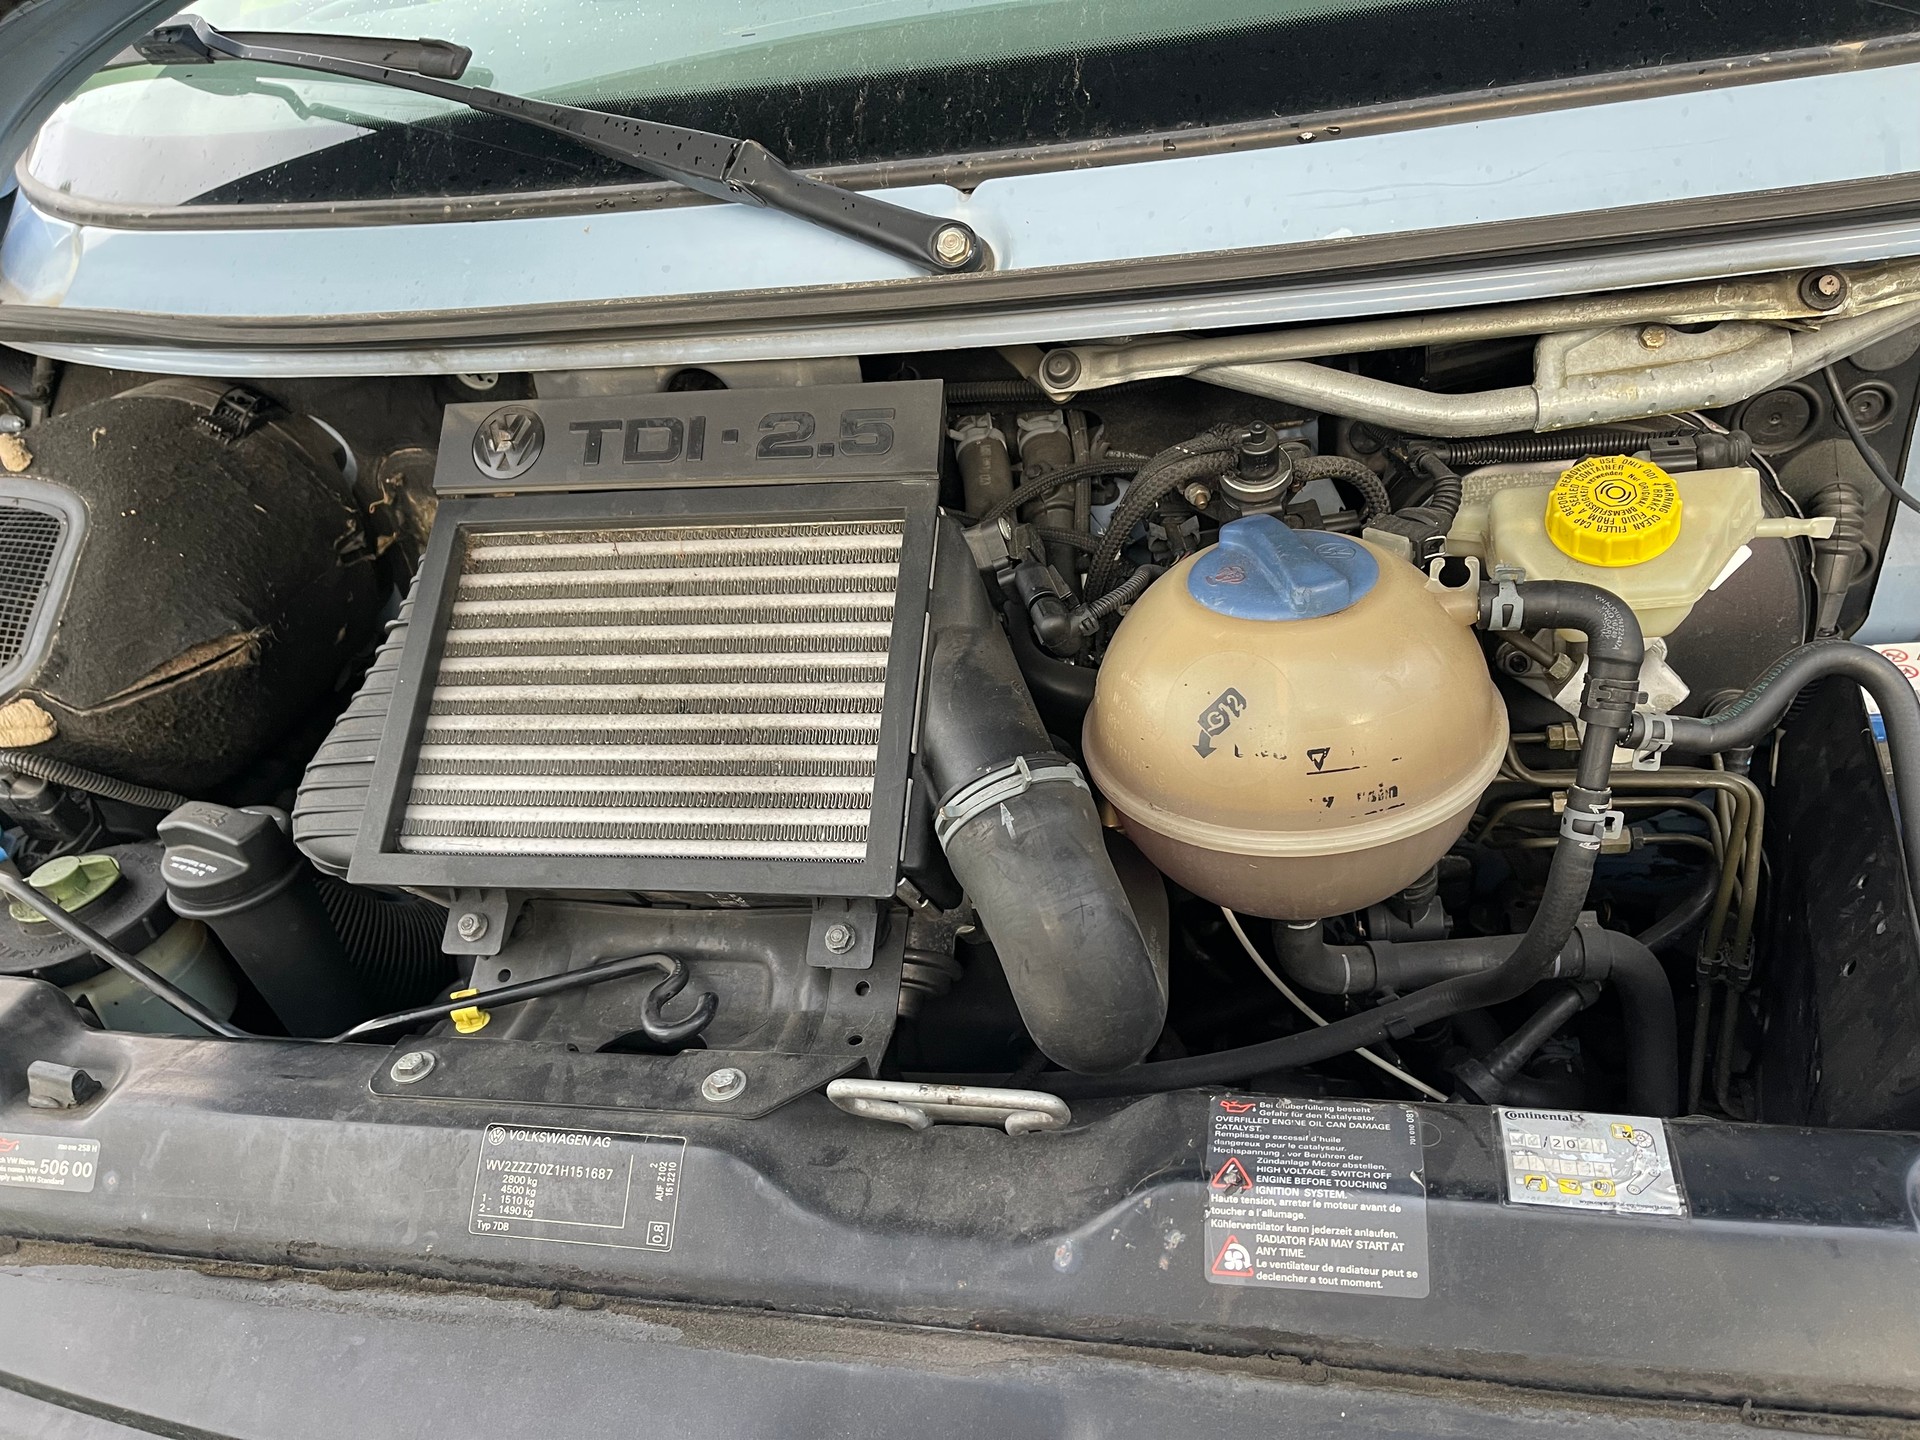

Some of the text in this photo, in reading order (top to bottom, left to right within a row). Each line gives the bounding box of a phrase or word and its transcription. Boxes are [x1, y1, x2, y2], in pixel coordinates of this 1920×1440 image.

[569, 415, 706, 466] TDI
[756, 408, 896, 461] 2.5
[1622, 458, 1645, 469] ONLY
[1560, 460, 1595, 488] REMOVING
[1575, 464, 1625, 482] CONTAINER
[1586, 471, 1624, 485] verwenden
[1643, 469, 1659, 480] DOT
[1568, 483, 1581, 507] SEALED
[1646, 488, 1663, 512] BRAKE
[1659, 482, 1674, 513] WARNING
[1557, 492, 1575, 517] BEFORE
[1574, 518, 1592, 529] CAP
[1588, 512, 1615, 525] FROM
[1621, 511, 1647, 525] FLUID
[1633, 514, 1661, 531] CLEAN
[1596, 524, 1627, 533] FILLER
[1207, 694, 1244, 733] G12
[1259, 1109, 1289, 1117] Gefahr
[1291, 1110, 1303, 1118] für
[1325, 1113, 1377, 1122] Katalysator.
[1405, 1110, 1414, 1123] 081
[1504, 1110, 1573, 1122] Continental
[1215, 1116, 1391, 1131] OVERFILLED ENGINE OIL CAN DAMAGE
[1215, 1123, 1263, 1132] CATALYST.
[509, 1129, 612, 1148] VOLKSWAGEN AG
[1214, 1131, 1342, 1143] Remplissage excessif d'huile
[1213, 1139, 1261, 1148] dangereux
[1298, 1143, 1347, 1152] catalyseur.
[1213, 1147, 1280, 1157] Hochspannung
[6, 1156, 18, 1165] VW
[1256, 1157, 1387, 1170] Zündanlage Motor abstellen.
[27, 1167, 39, 1175] VW
[40, 1159, 93, 1178] 506 00
[486, 1159, 614, 1181] WV2ZZZ70Z1H151687
[1331, 1169, 1371, 1178] SWITCH
[1373, 1171, 1392, 1179] OFF
[25, 1175, 37, 1183] VW
[502, 1174, 538, 1188] 2800 kg
[655, 1161, 668, 1202] AUF Z102
[665, 1161, 677, 1196] 1512210
[1256, 1175, 1388, 1190] ENGINE BEFORE TOUCHING
[500, 1184, 537, 1198] 4500 kg
[1255, 1186, 1348, 1199] IGNITION SYSTEM.
[500, 1194, 523, 1205] 1510
[524, 1197, 535, 1208] kg
[1210, 1194, 1239, 1204] Haute
[1240, 1196, 1277, 1206] tension,
[1313, 1199, 1322, 1208] le
[1324, 1201, 1359, 1210] moteur
[1360, 1203, 1388, 1212] avant
[1389, 1204, 1402, 1213] de
[499, 1205, 522, 1216] 1490
[522, 1207, 534, 1218] kg
[1210, 1206, 1246, 1216] toucher
[1256, 1208, 1307, 1221] l'allumage.
[476, 1219, 491, 1231] Typ
[1210, 1218, 1399, 1239] Kühlerventilator kann jederzeit anlaufen.
[652, 1224, 664, 1243] 0,8
[1256, 1234, 1405, 1252] RADIATOR FAN MAY START AT
[1255, 1247, 1307, 1259] ANY TIME.
[1256, 1259, 1419, 1279] Le ventilateur de radiateur peut se
[1256, 1271, 1384, 1289] declencher a tout moment.
